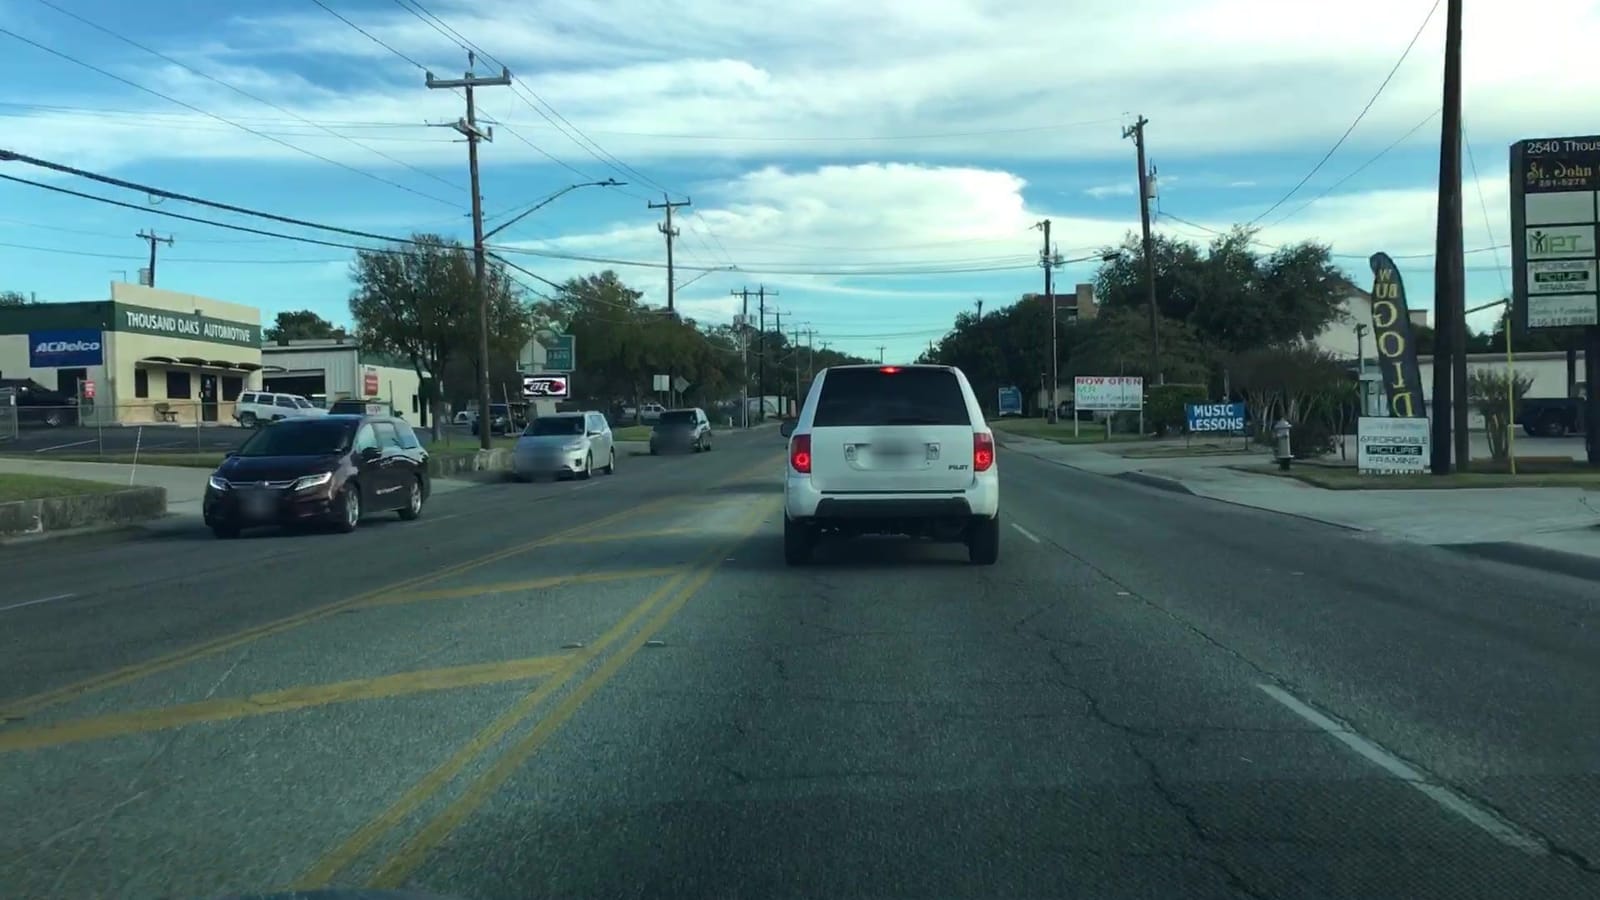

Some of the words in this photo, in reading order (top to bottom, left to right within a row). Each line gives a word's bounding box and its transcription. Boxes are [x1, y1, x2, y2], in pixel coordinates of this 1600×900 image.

[1527, 141, 1560, 154] 2540
[1553, 160, 1592, 178] John
[125, 311, 176, 332] THOUSAND
[177, 319, 200, 335] OAKS
[203, 321, 251, 343] AUTOMOTIVE
[35, 340, 101, 353] ACDelco
[1076, 377, 1105, 385] NOW
[1107, 377, 1142, 385] OPEN
[1193, 403, 1235, 417] MUSIC
[1188, 416, 1244, 431] LESSONS
